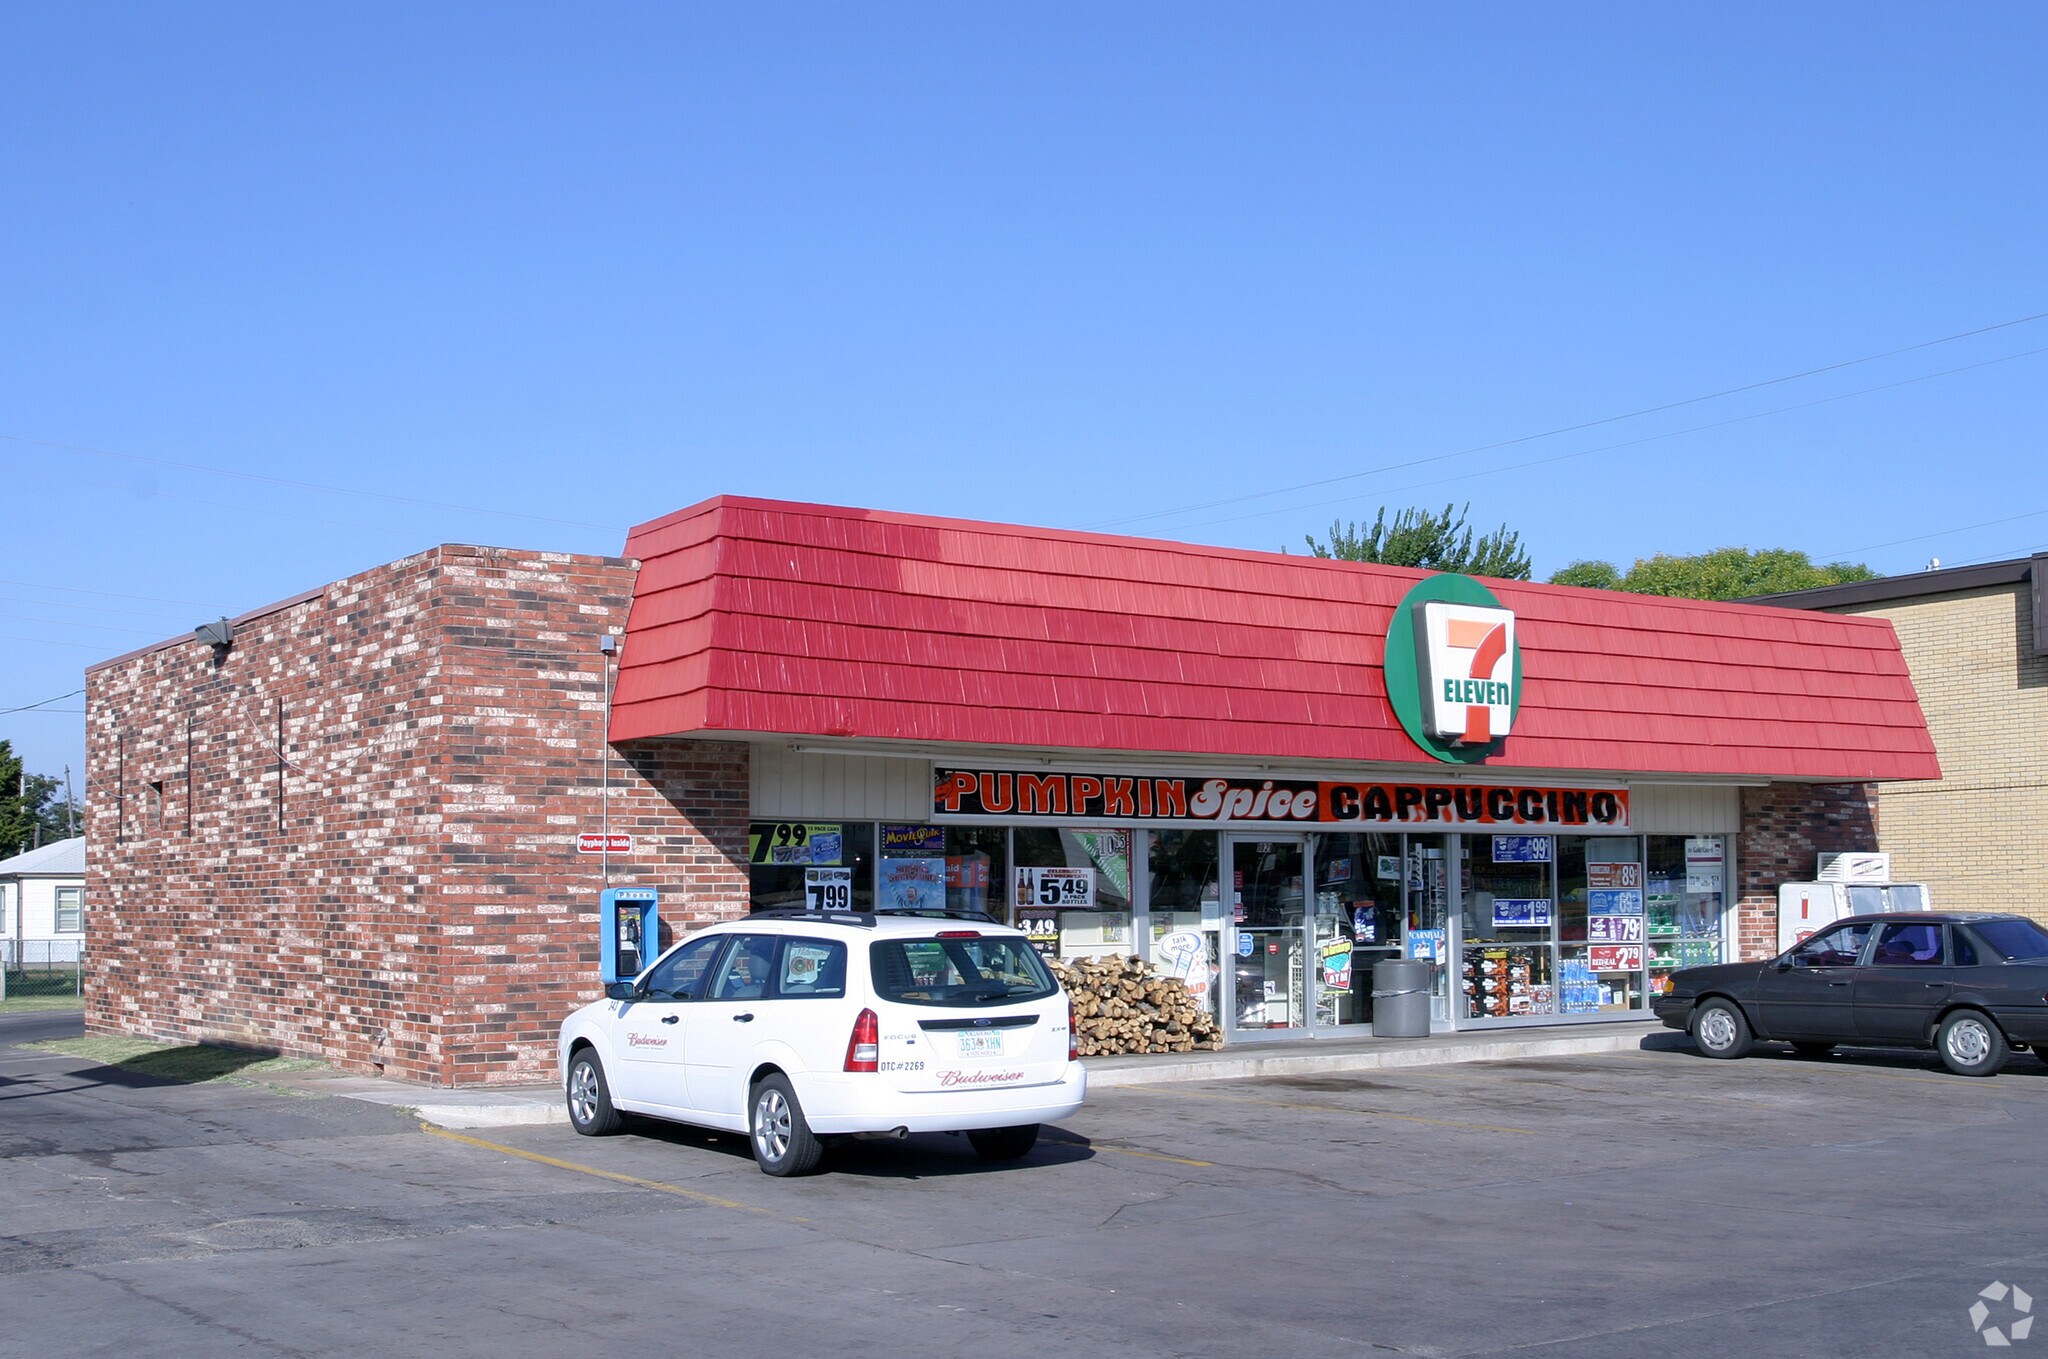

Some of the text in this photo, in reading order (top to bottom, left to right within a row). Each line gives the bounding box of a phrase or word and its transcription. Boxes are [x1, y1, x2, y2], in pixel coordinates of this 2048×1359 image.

[1446, 618, 1507, 743] 7
[944, 771, 1619, 825] PUMPKIN Spice CAPPUCCINO
[611, 838, 630, 847] Inside
[1172, 936, 1187, 944] talk
[1328, 972, 1348, 984] ATM
[1188, 982, 1207, 995] AID
[626, 1032, 668, 1048] Budweiser
[881, 1061, 925, 1072] OTC#2269
[935, 1069, 1025, 1087] Budweiser
